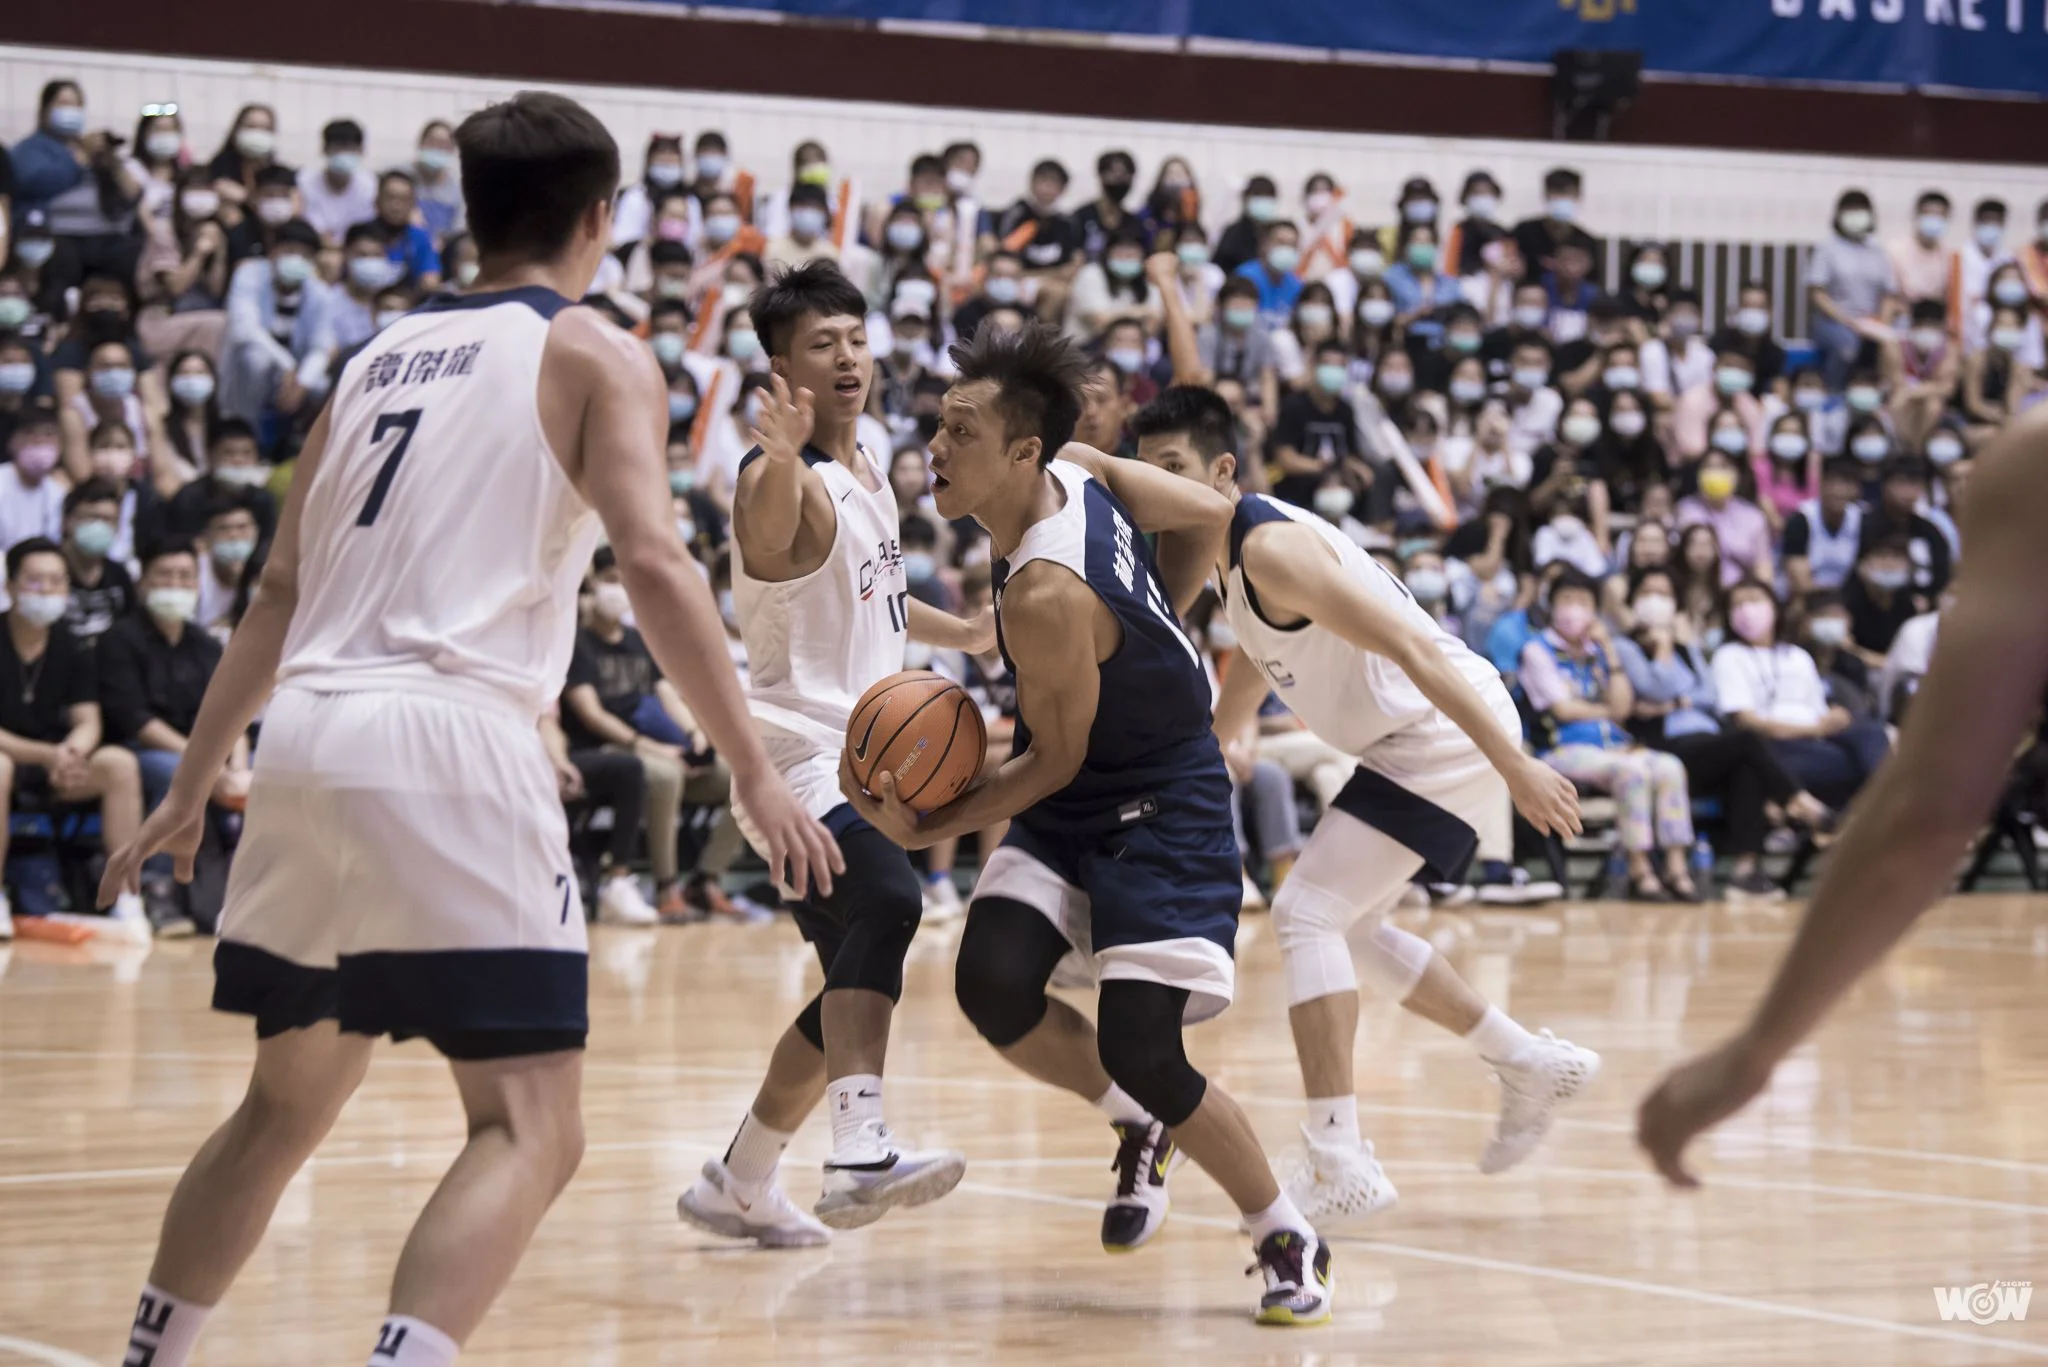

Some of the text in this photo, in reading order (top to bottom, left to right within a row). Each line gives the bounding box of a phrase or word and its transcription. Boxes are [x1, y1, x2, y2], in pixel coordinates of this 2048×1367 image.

[1771, 0, 2048, 33] ASKET
[365, 340, 486, 393] 譚傑龍
[355, 408, 424, 527] 7
[555, 873, 571, 925] 7
